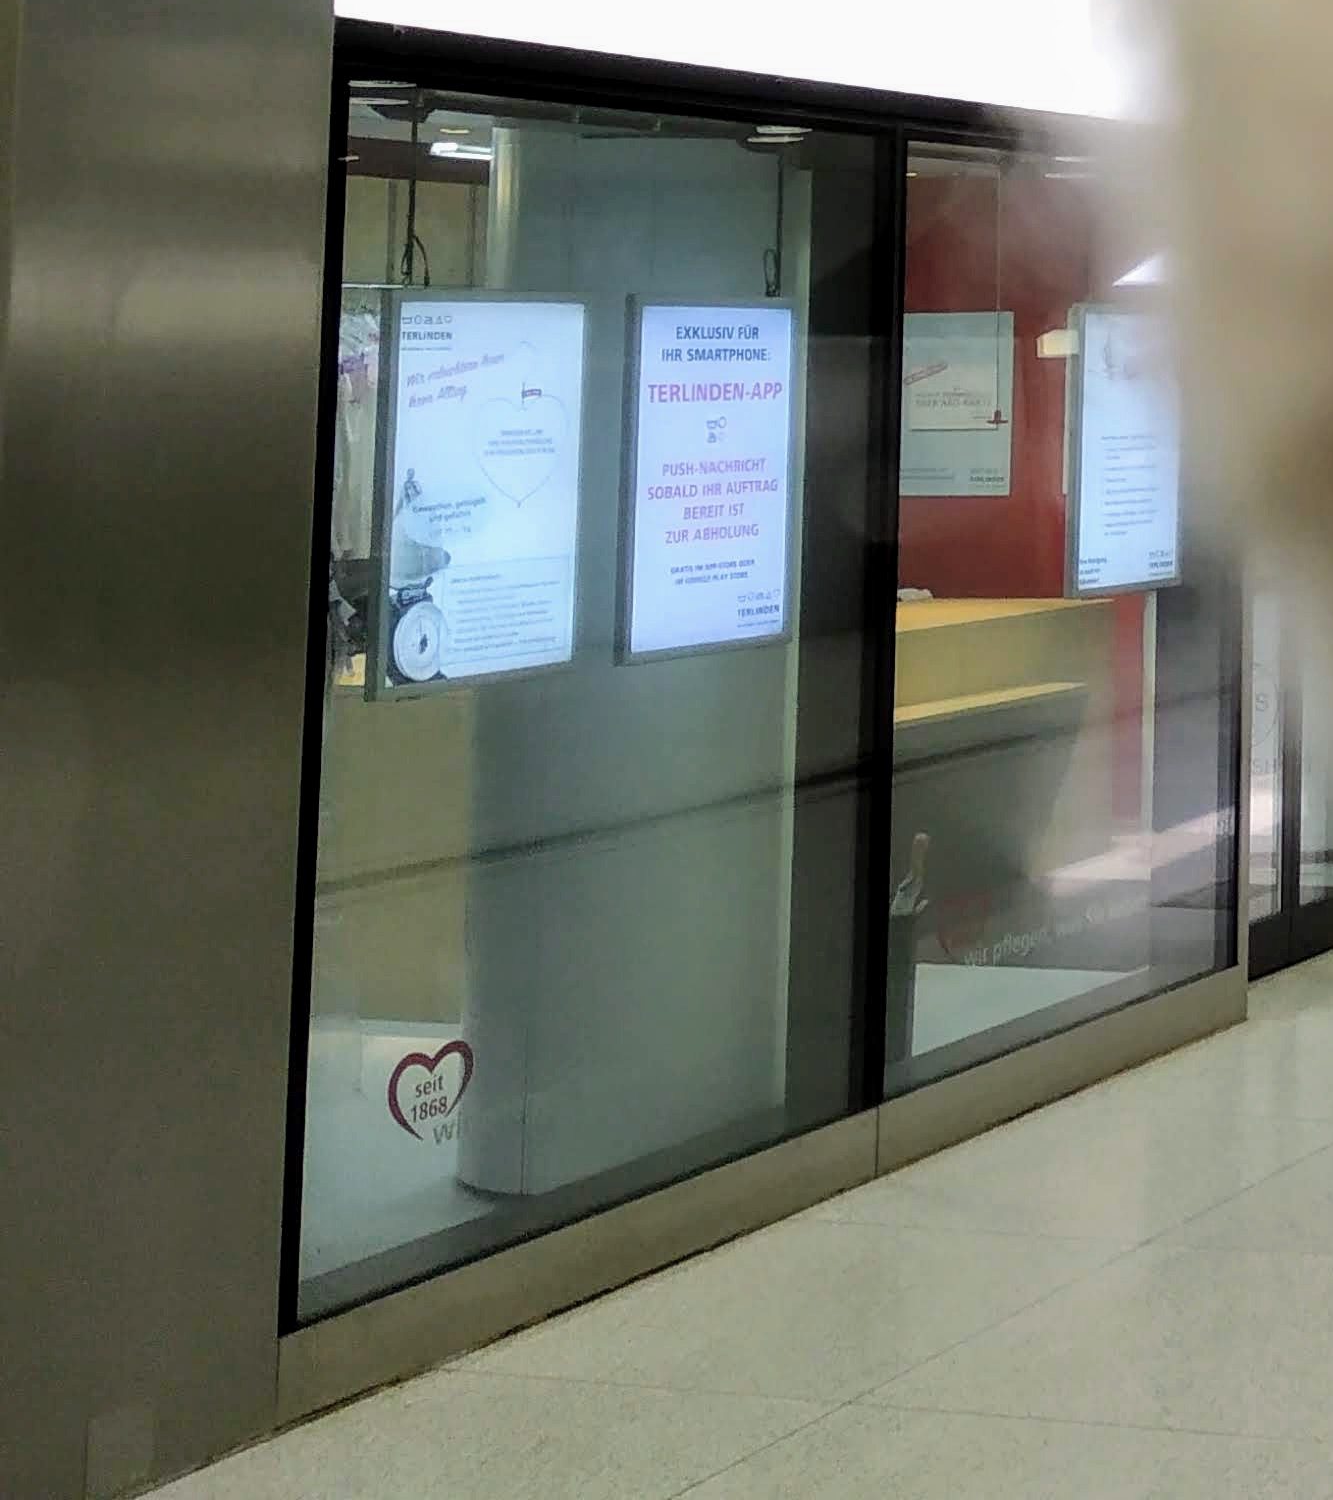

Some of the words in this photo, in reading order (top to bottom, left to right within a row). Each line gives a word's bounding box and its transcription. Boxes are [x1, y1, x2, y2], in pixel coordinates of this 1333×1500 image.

[401, 331, 453, 341] TERLINDEN
[676, 326, 734, 340] EXKLUSIV
[738, 324, 759, 339] FÜR
[662, 349, 682, 362] IHR
[648, 382, 783, 403] TERLINDEN-APP
[662, 458, 767, 476] PUSH-NACHRICHT
[648, 484, 698, 500] SOBALD
[702, 483, 722, 496] IHR
[726, 479, 778, 495] AUFTRAG
[683, 504, 724, 520] BEREIT
[728, 503, 744, 516] IST
[665, 530, 689, 544] ZUR
[693, 524, 760, 541] ABHOLUNG
[415, 1074, 443, 1098] seit
[411, 1096, 448, 1123] 1868
